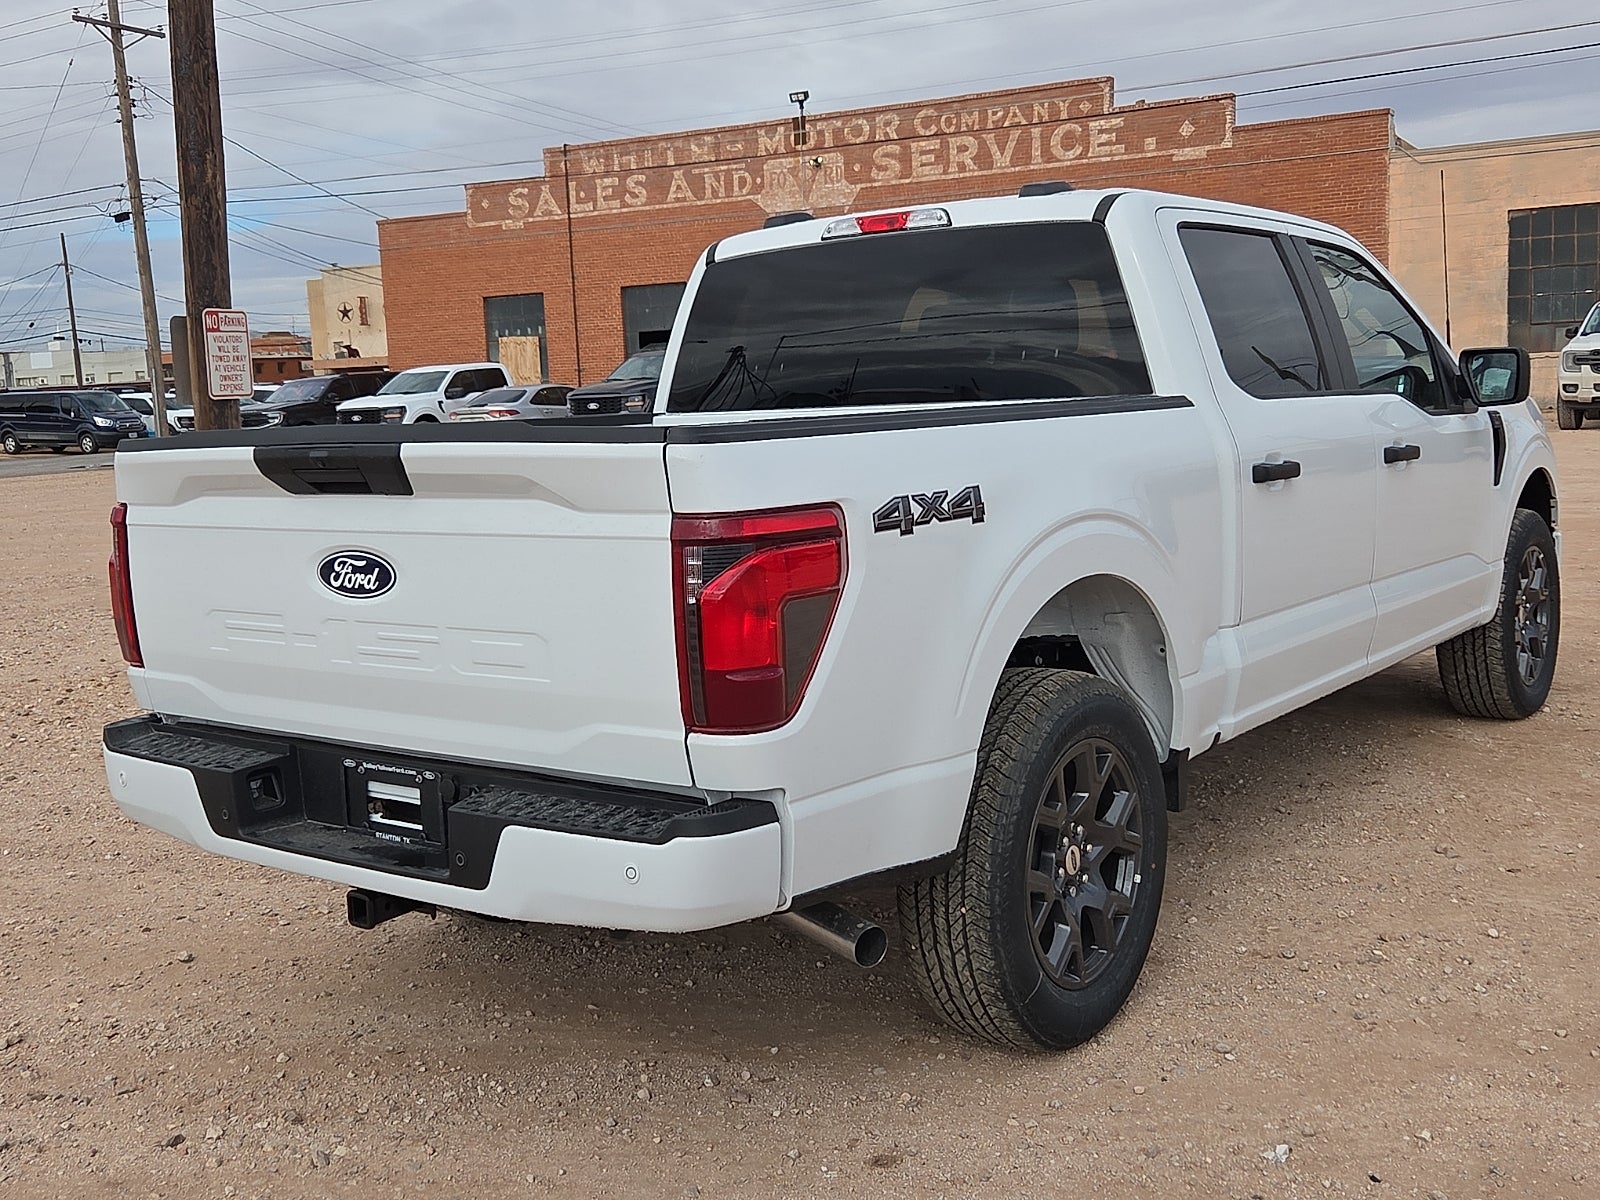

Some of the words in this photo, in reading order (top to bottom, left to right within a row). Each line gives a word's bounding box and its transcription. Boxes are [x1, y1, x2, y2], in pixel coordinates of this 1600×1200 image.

[507, 175, 647, 218] SALES
[667, 167, 752, 203] AND
[870, 117, 1125, 181] SERVICE
[205, 314, 219, 329] NO
[220, 315, 246, 328] PARKING
[213, 335, 243, 343] VIOLATORS
[217, 345, 231, 354] WILL
[232, 345, 241, 354] BE
[212, 354, 231, 363] TOWED
[232, 354, 247, 363] AWAY
[214, 364, 222, 373] AT
[223, 363, 246, 373] VEHICLE
[219, 384, 245, 393] EXPENSE
[329, 557, 380, 591] Ford
